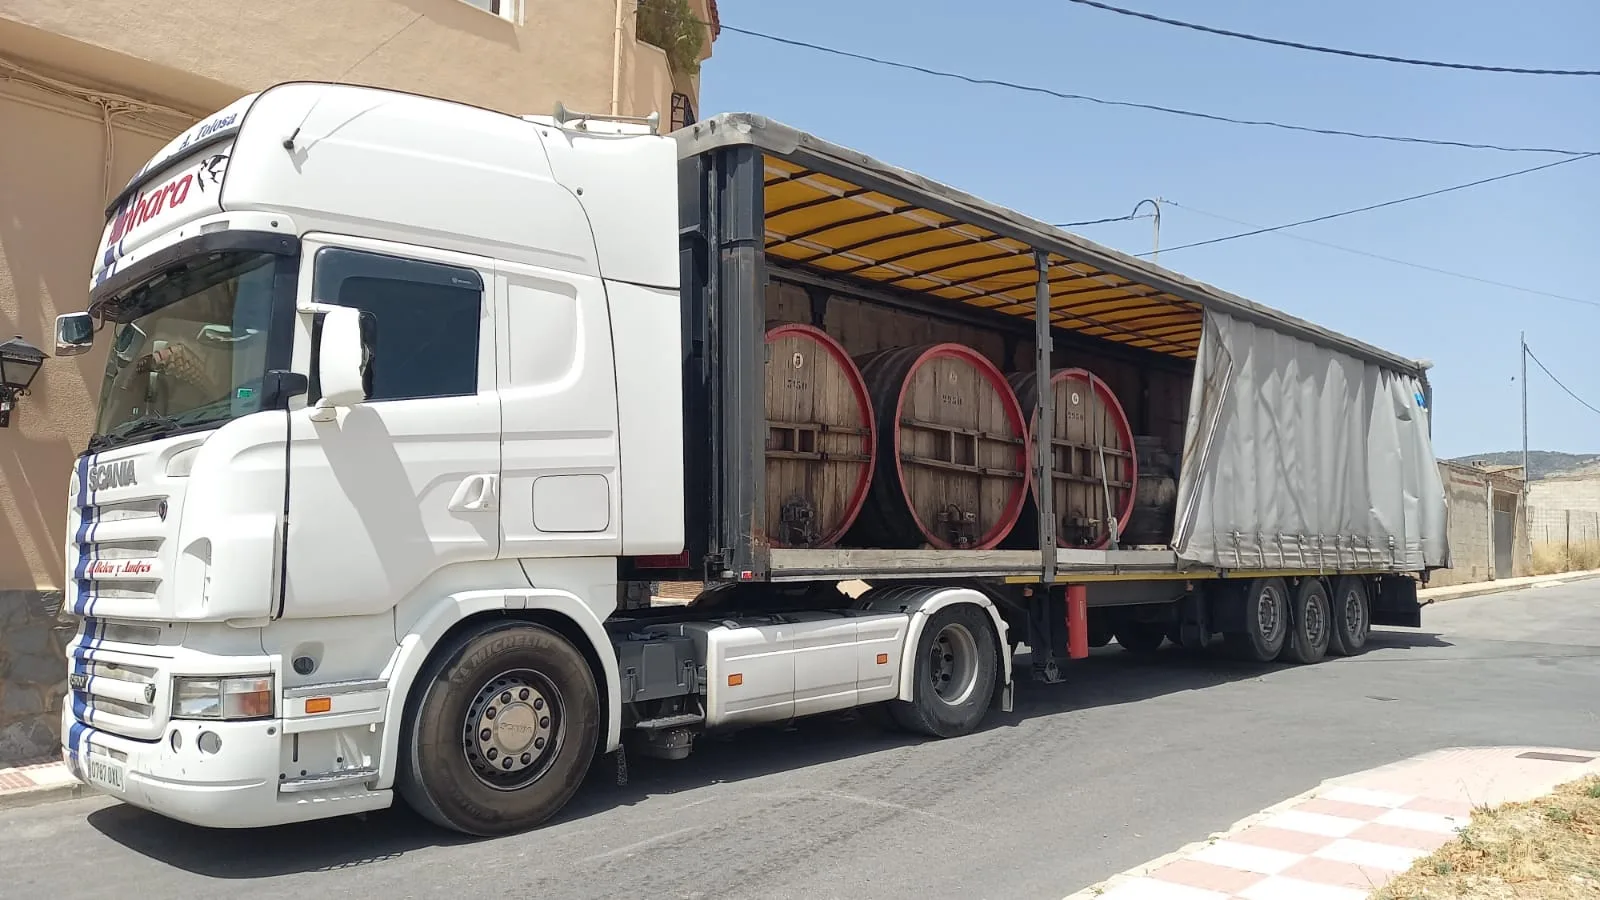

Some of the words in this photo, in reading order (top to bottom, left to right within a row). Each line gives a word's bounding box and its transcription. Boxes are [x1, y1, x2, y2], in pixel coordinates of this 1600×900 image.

[194, 113, 238, 141] Tolosa
[89, 460, 137, 491] SCANIA
[470, 634, 551, 668] MICHELIN
